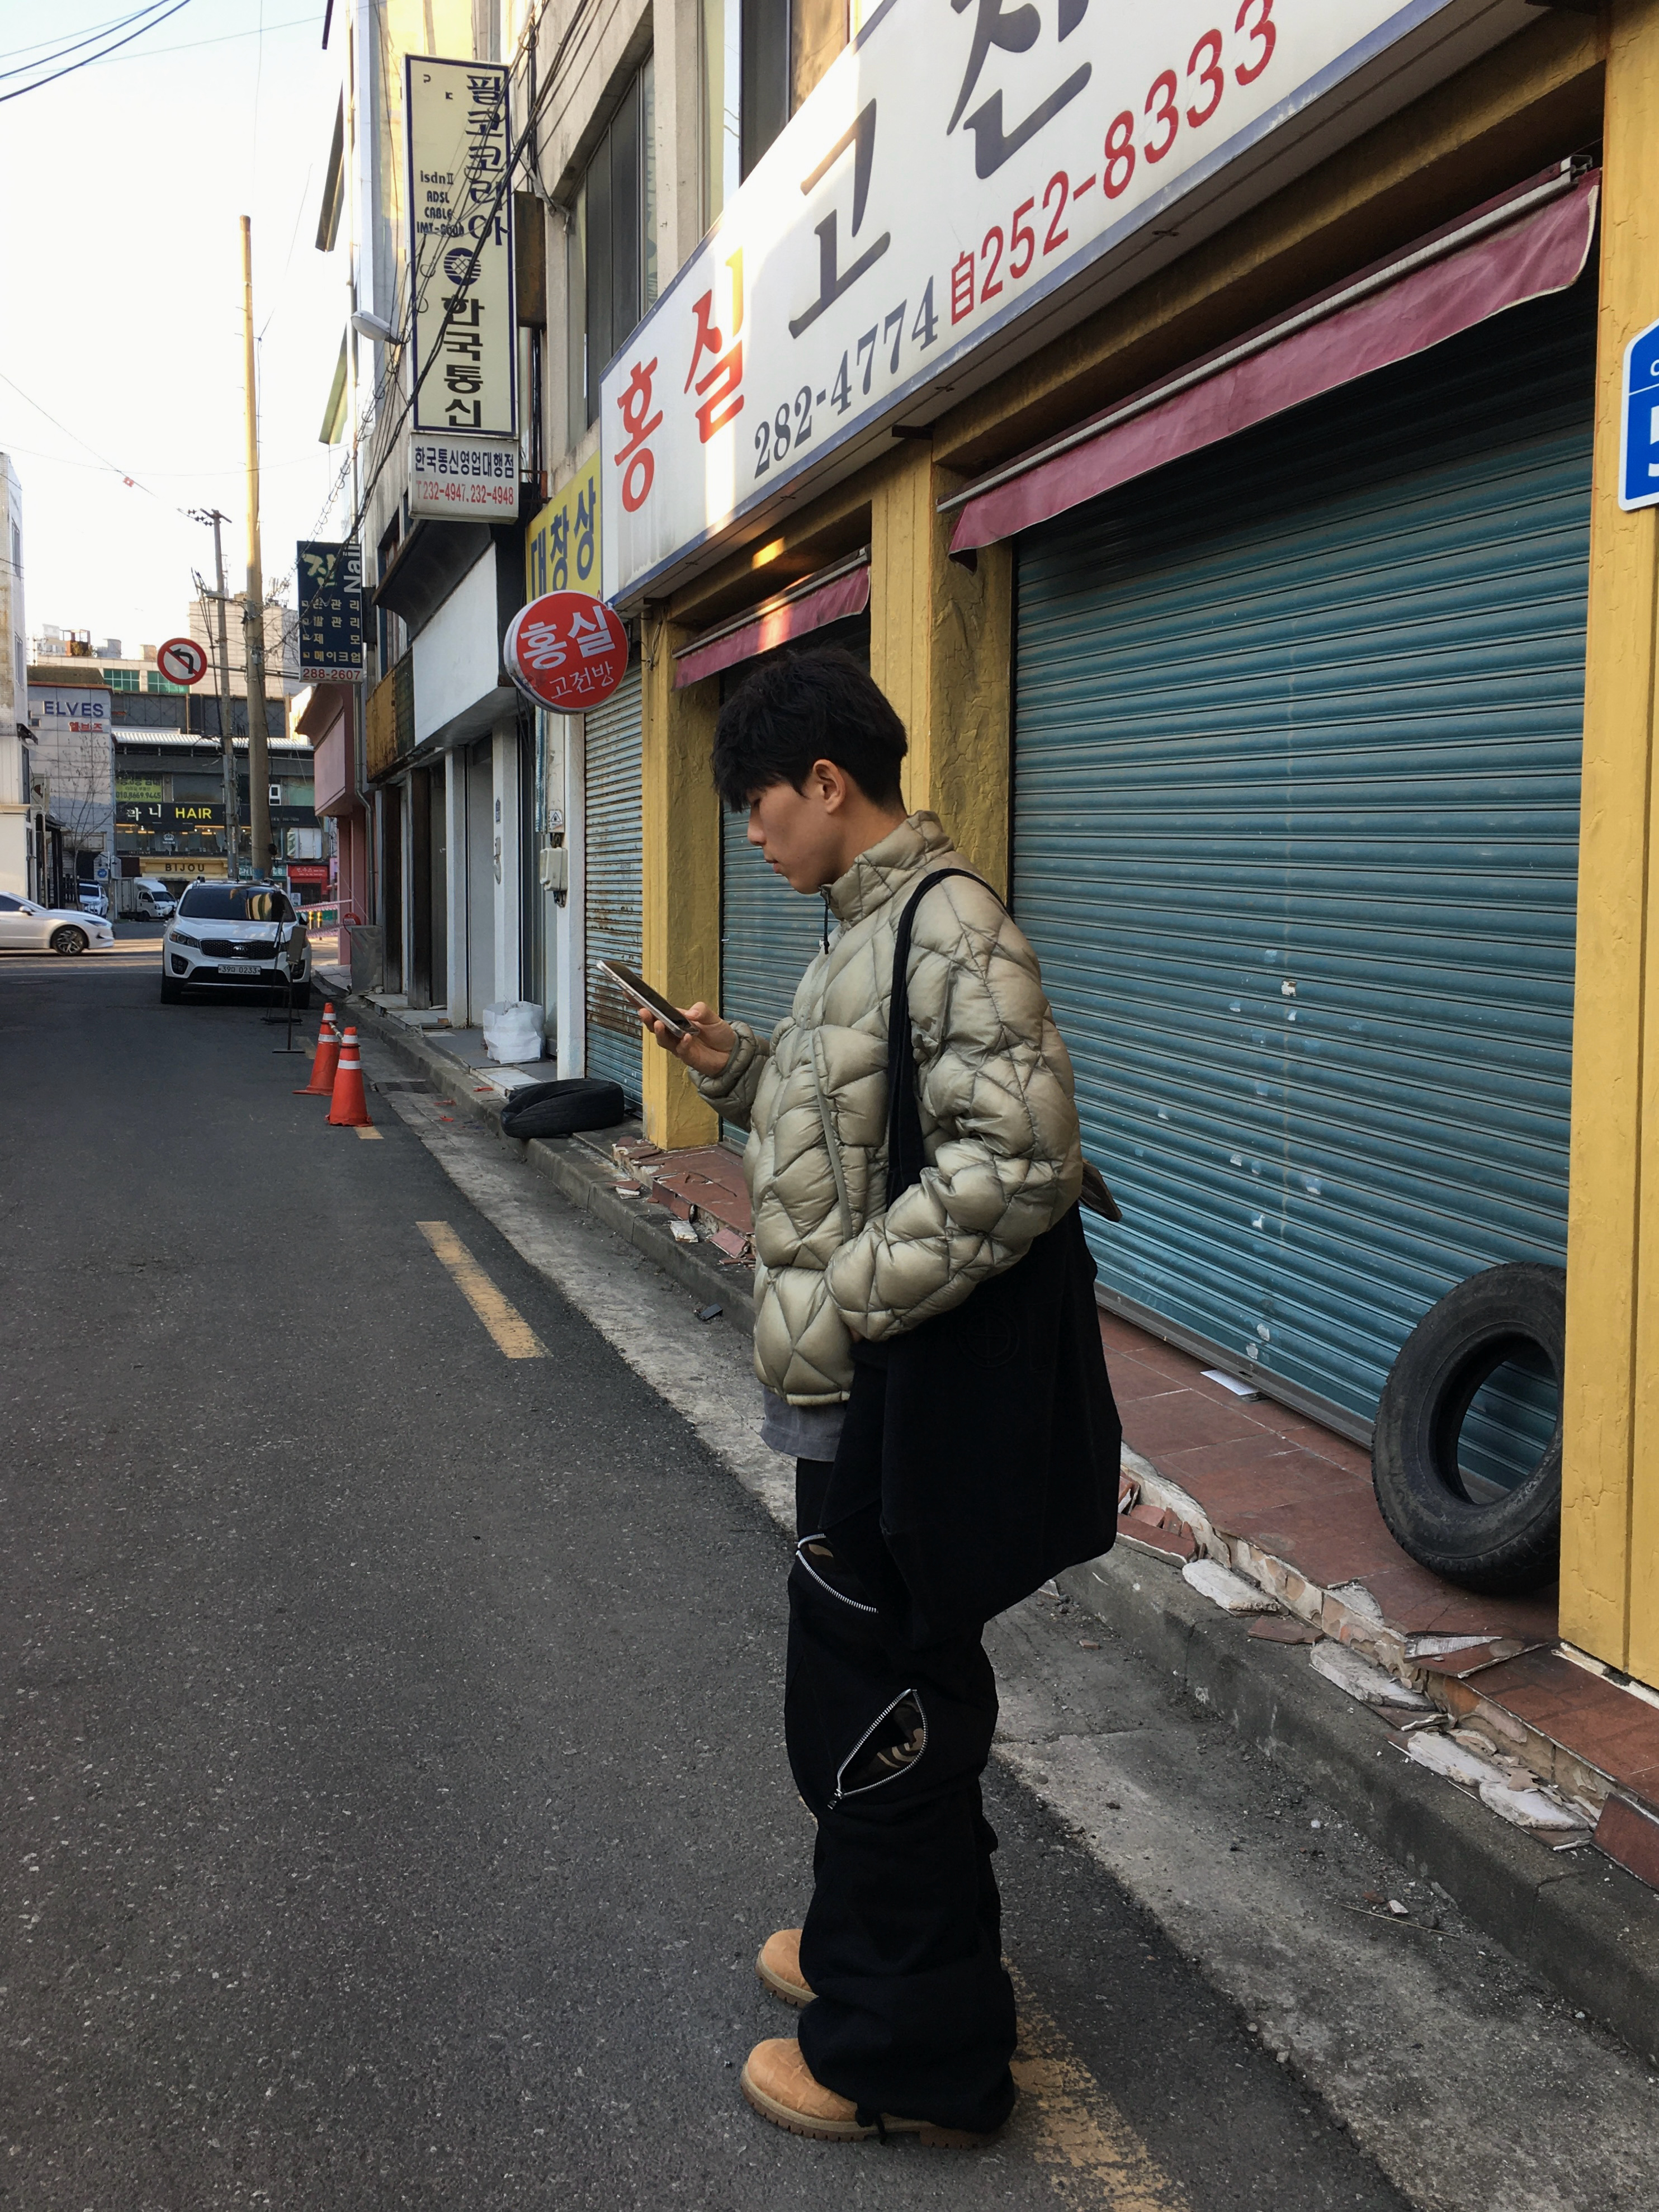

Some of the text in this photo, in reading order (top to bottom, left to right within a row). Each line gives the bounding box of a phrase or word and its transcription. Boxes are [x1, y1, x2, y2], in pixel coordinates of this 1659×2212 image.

[441, 296, 485, 428] 한국통신
[753, 275, 940, 480] 282-4774
[615, 247, 745, 513] 홍실
[415, 446, 514, 479] 한국통신영업대행점
[342, 545, 362, 593] Nail
[520, 606, 616, 670] 홍실
[303, 668, 361, 680] 288-2607
[314, 651, 361, 664] 메이크업
[549, 661, 615, 699] 고전방
[43, 701, 103, 717] ELVES
[175, 807, 212, 819] HAIR
[165, 863, 205, 872] BIJOU
